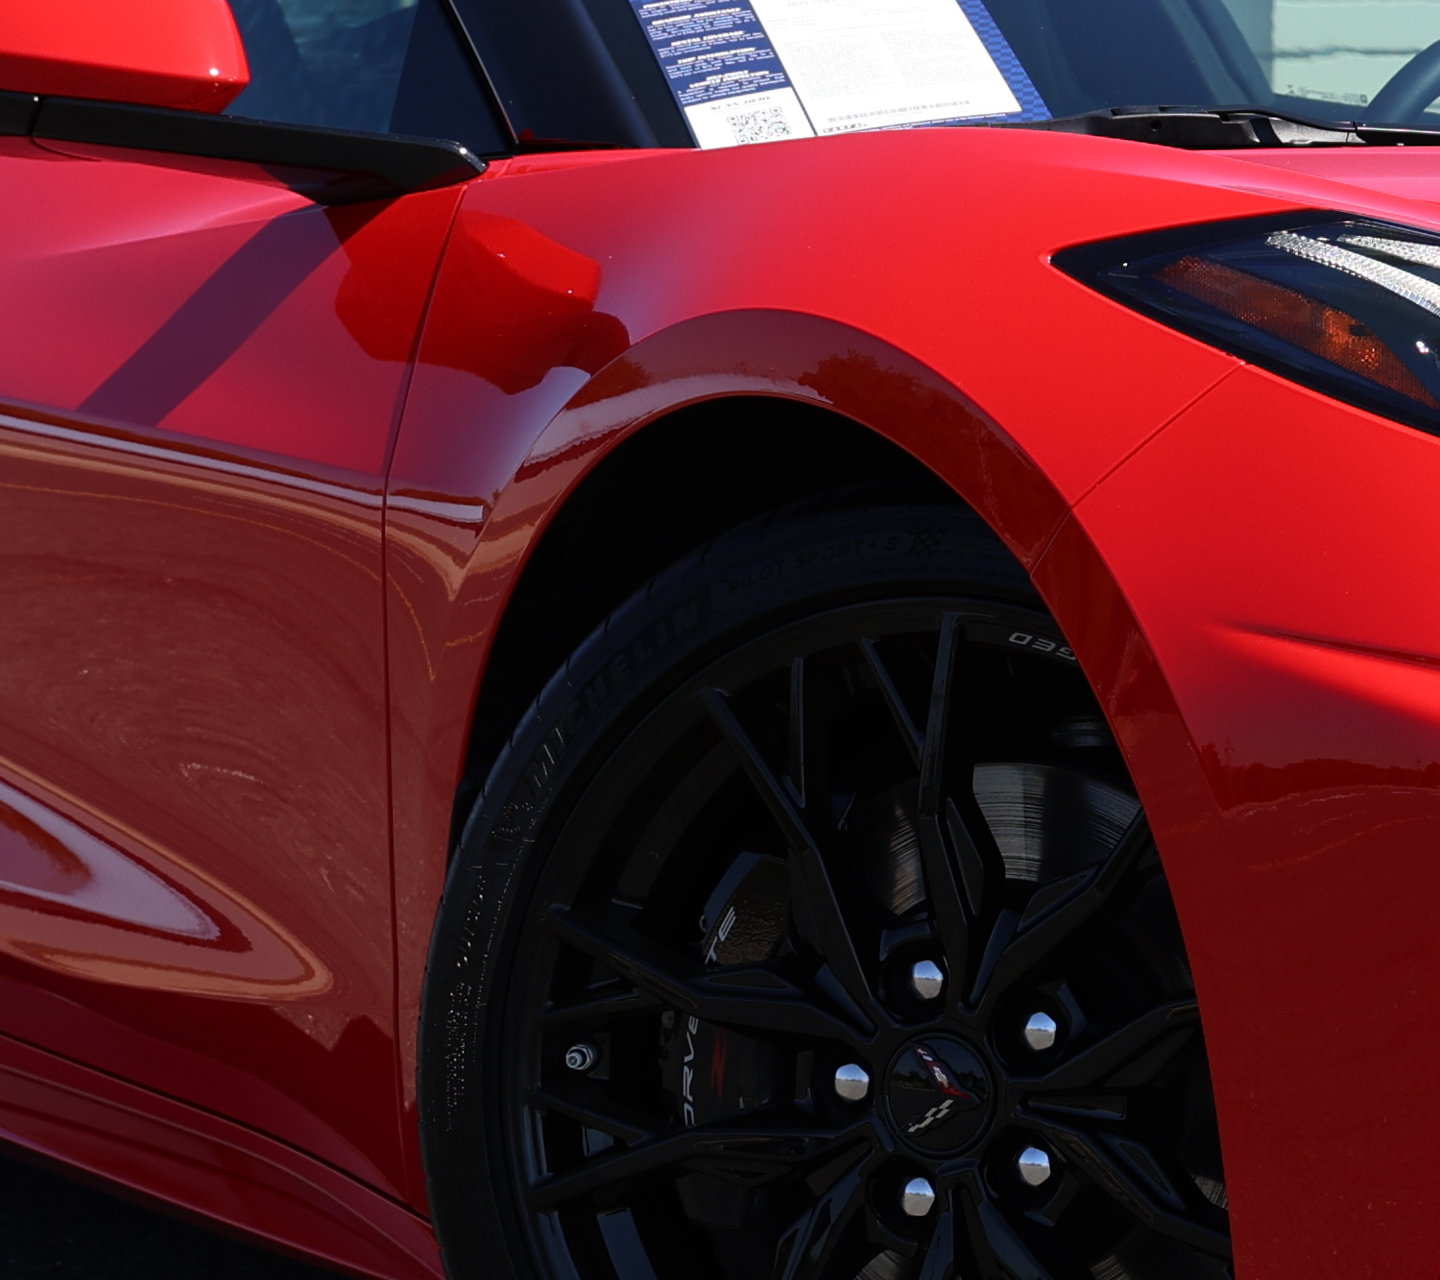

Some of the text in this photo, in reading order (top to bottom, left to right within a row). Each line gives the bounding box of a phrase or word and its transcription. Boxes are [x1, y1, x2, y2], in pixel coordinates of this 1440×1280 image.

[727, 559, 785, 596] PILOT
[794, 540, 861, 570] SPORT
[885, 535, 898, 552] S
[521, 596, 702, 796] MICHELIN
